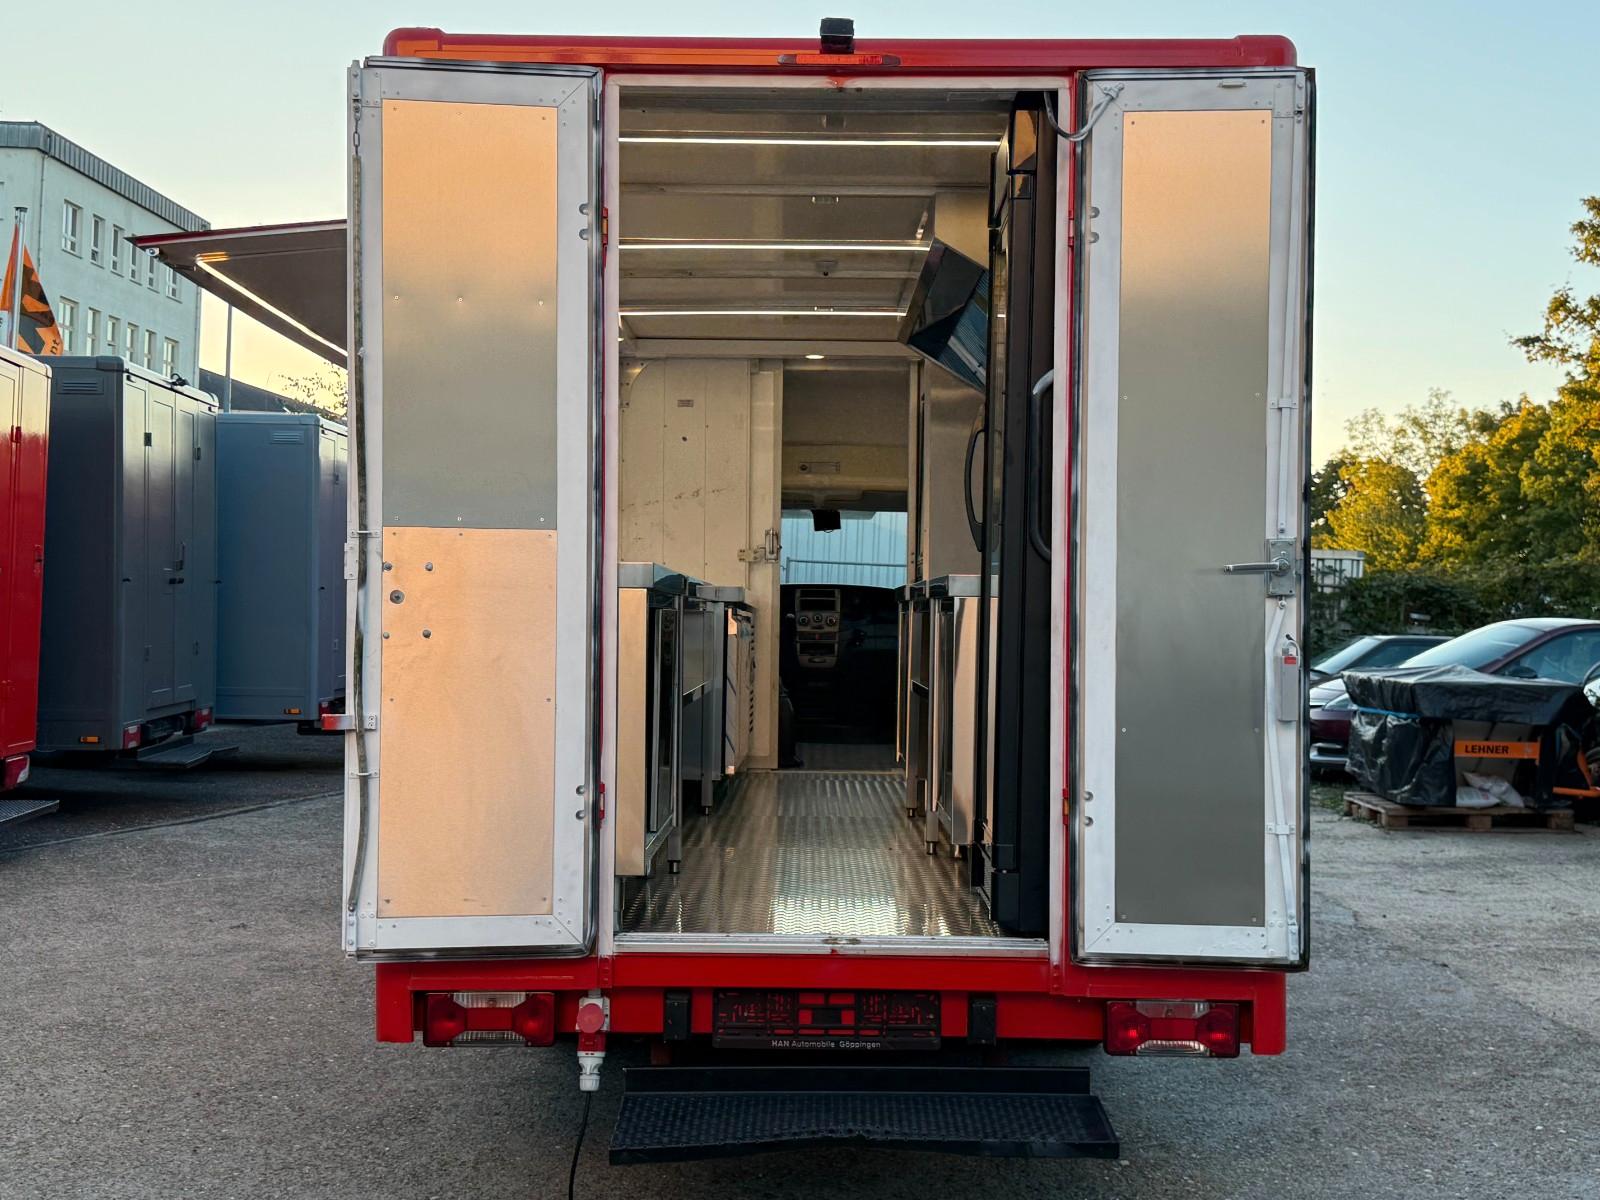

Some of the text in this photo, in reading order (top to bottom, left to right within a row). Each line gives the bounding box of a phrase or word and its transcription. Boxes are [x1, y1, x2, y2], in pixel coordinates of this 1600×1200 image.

[1464, 744, 1509, 754] LEHNER
[791, 1040, 835, 1048] Automobile
[839, 1040, 881, 1049] Göppingen
